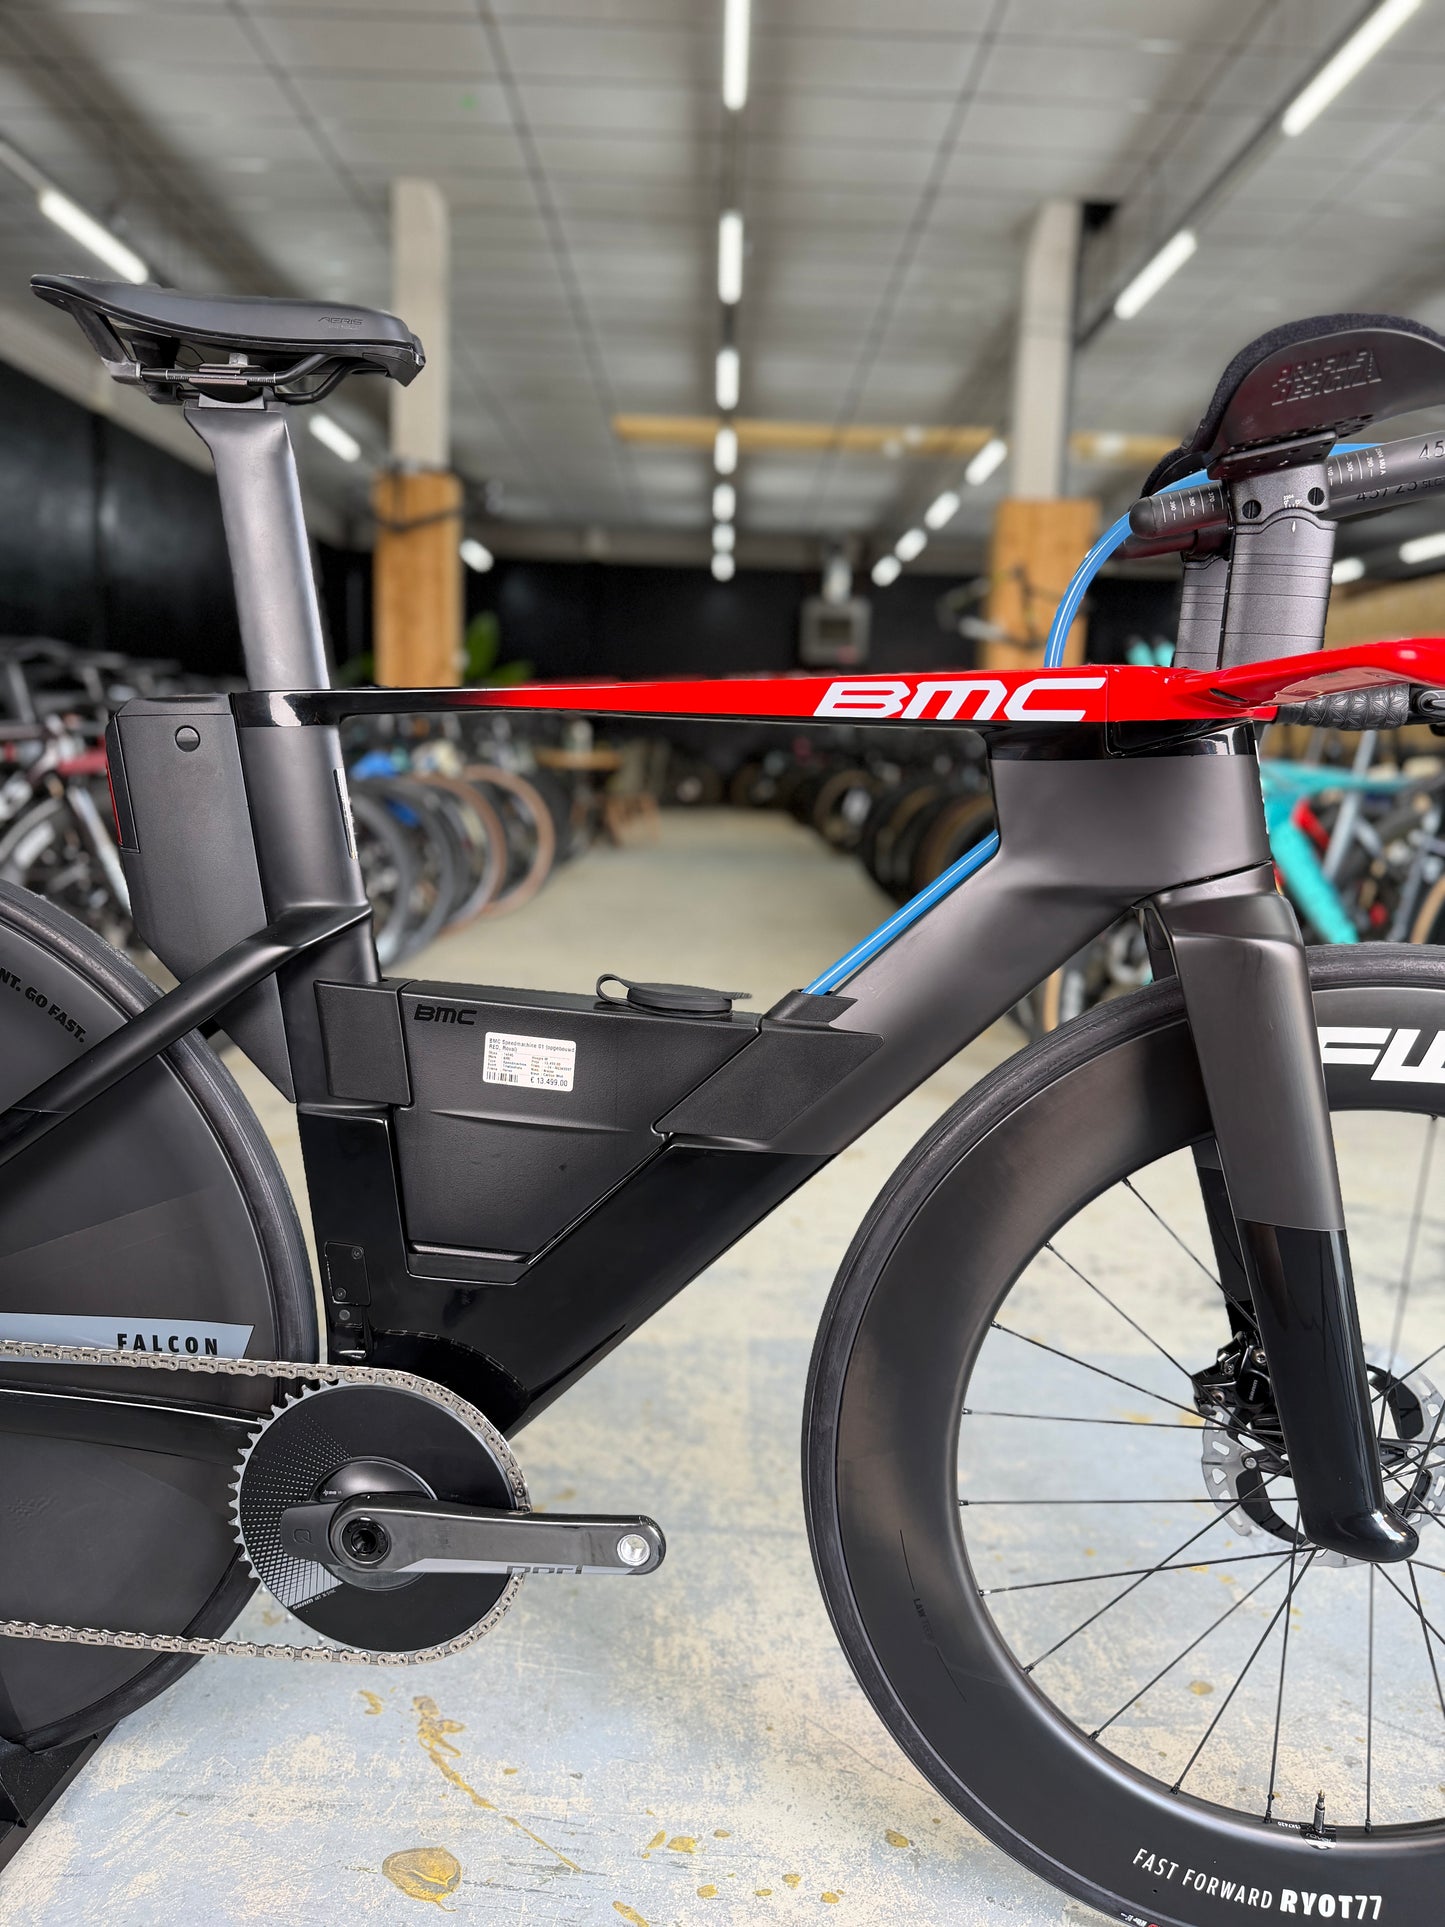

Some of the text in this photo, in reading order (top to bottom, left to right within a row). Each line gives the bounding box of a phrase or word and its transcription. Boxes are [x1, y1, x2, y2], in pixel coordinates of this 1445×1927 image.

[813, 677, 1107, 721] BMC
[25, 986, 48, 1008] GO
[48, 1003, 86, 1042] FAST.
[414, 1004, 477, 1025] BMC
[117, 1333, 217, 1355] FALCON
[1132, 1848, 1383, 1921] FAST FORWARD RYOT77
